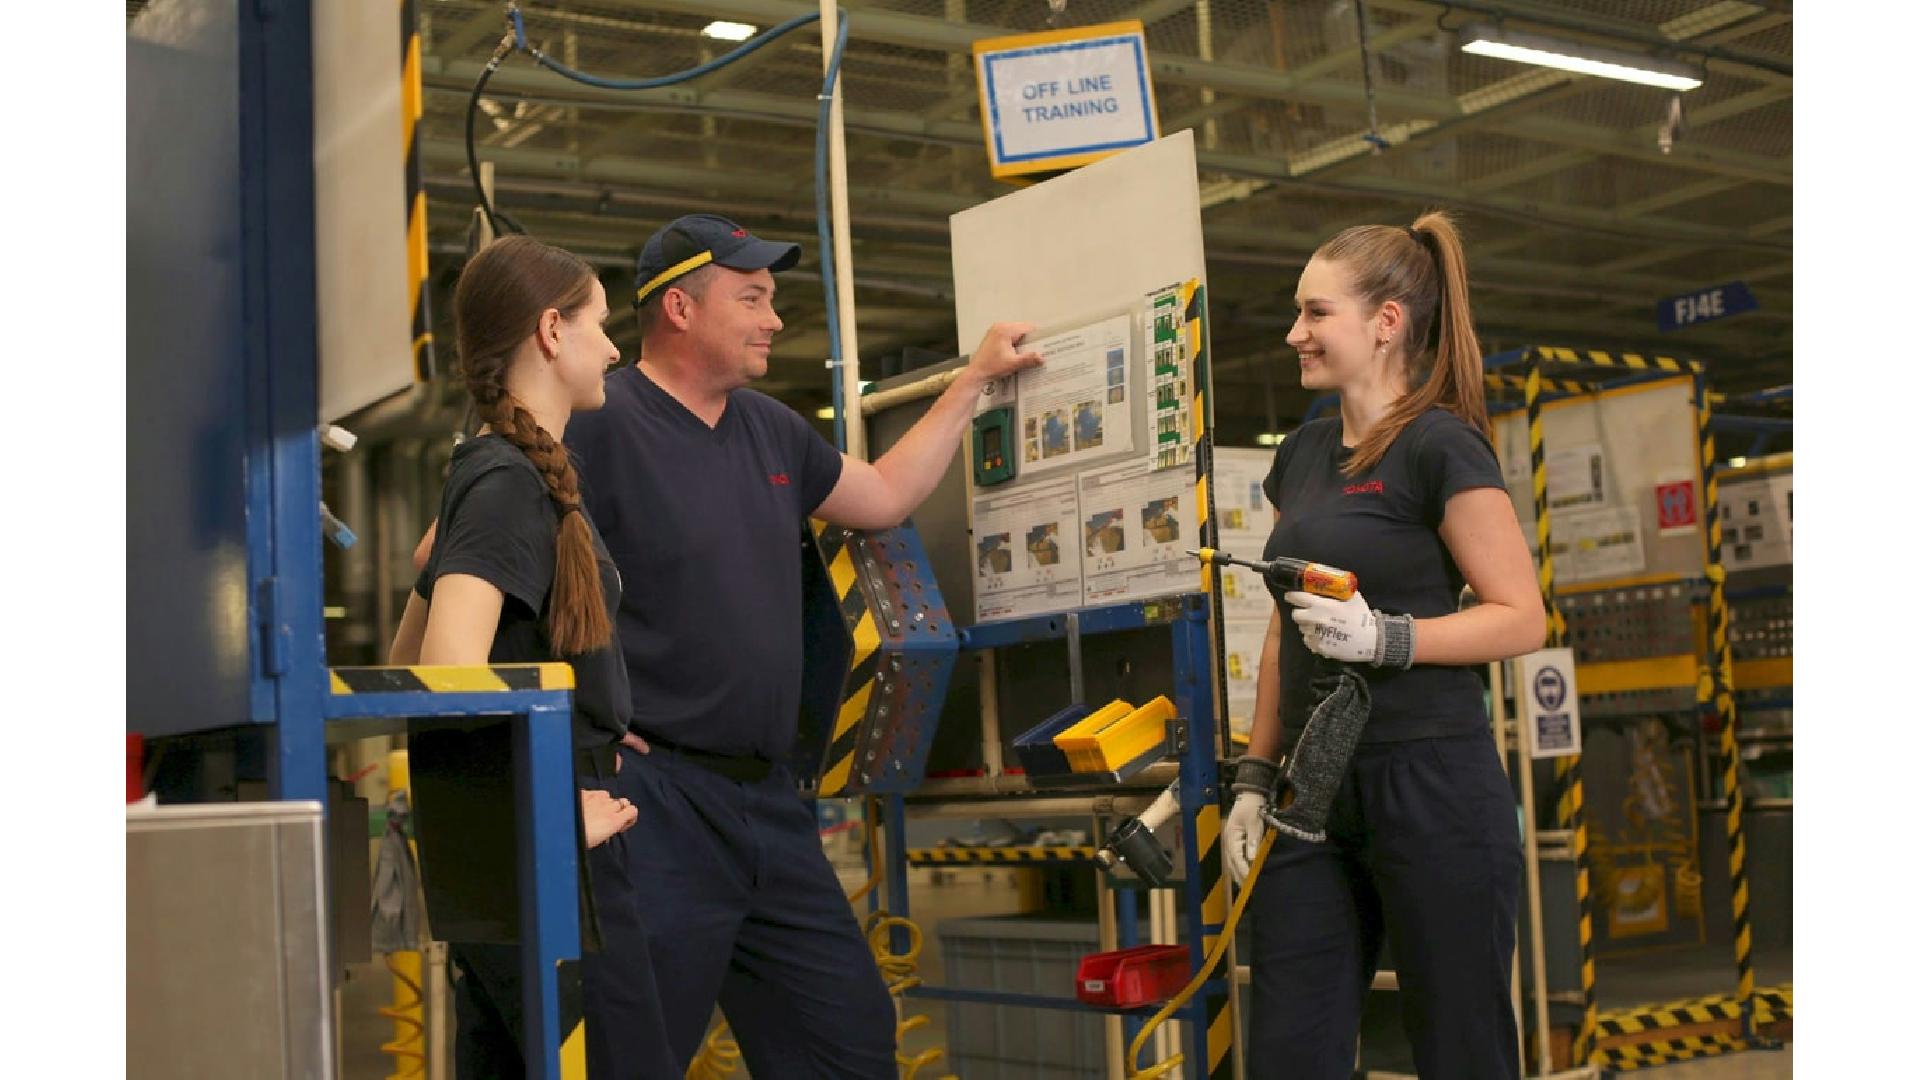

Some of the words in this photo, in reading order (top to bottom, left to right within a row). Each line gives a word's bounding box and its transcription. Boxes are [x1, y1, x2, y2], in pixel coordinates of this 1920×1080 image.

[1022, 81, 1061, 100] OFF
[1067, 75, 1113, 95] LINE
[1022, 97, 1119, 123] TRAINING
